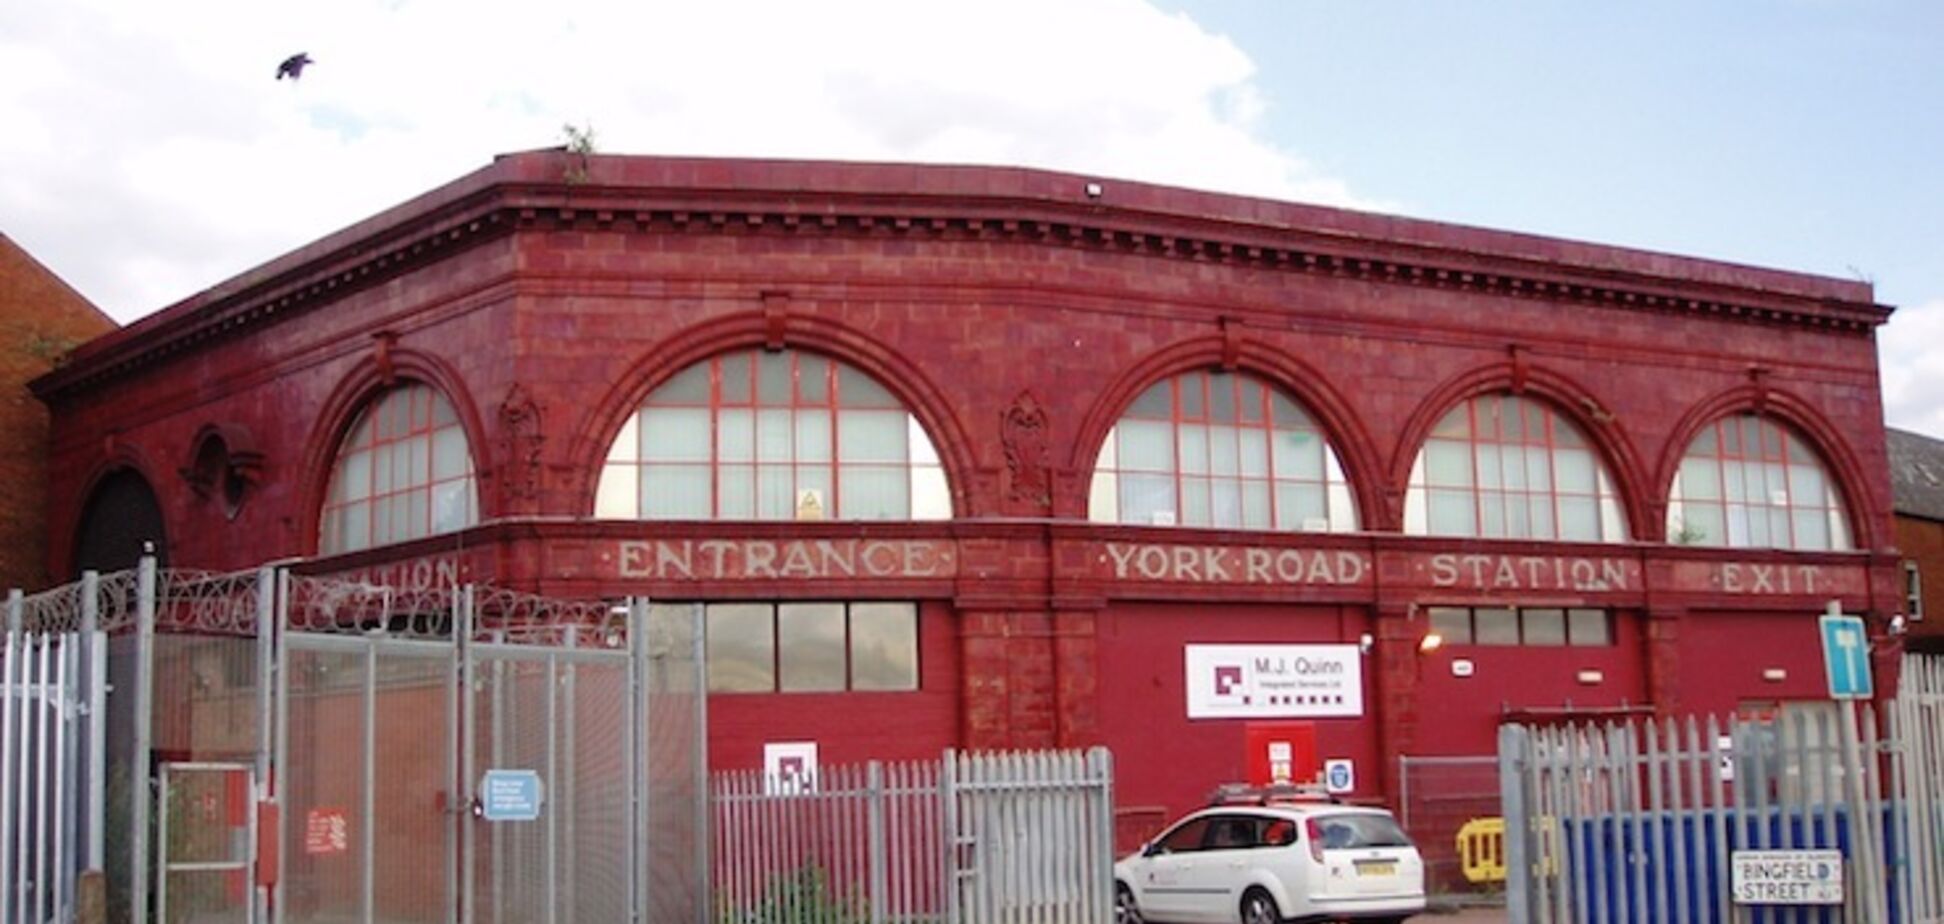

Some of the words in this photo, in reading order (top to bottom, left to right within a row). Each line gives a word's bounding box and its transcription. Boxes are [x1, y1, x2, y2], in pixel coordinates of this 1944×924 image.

[617, 540, 937, 578] ENTRANCE
[1105, 543, 1231, 581] YORK
[1247, 548, 1363, 584] ROAD
[1431, 554, 1629, 590] STATION
[1721, 563, 1823, 594] EXIT
[1254, 657, 1290, 675] M.J.
[1294, 656, 1344, 675] Quinn
[1742, 862, 1831, 880] BINGFIELD
[1742, 882, 1813, 900] STREET
